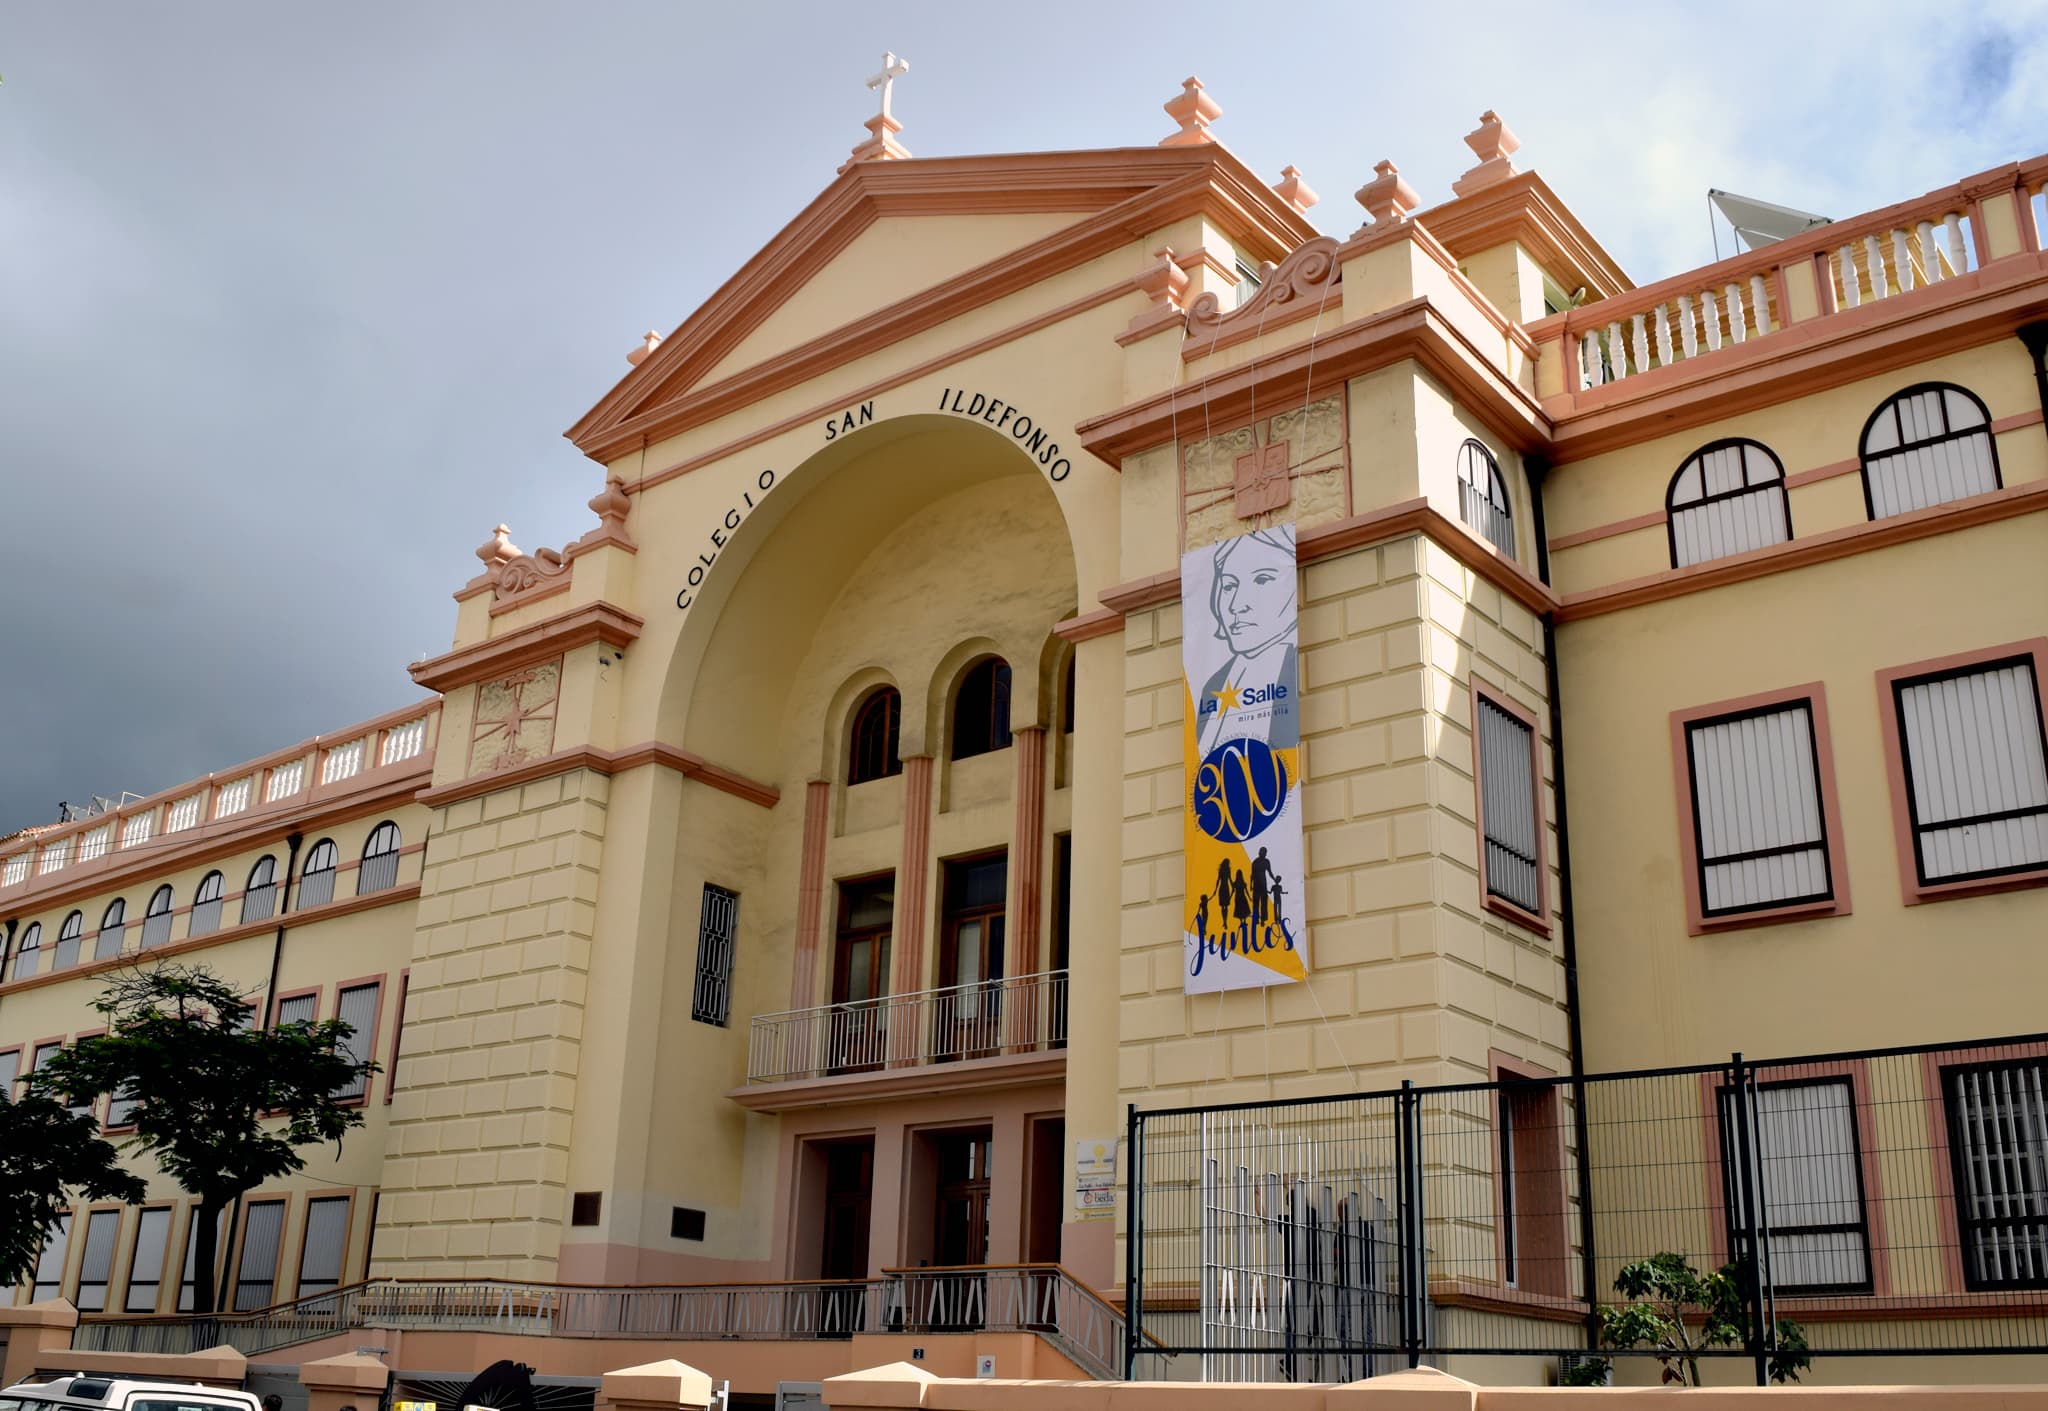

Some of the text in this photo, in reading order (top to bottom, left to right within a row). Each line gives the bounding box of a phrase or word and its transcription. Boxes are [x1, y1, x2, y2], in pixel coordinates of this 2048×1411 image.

[676, 388, 1071, 610] COLEGIO SAN ILDEFONSO
[1200, 683, 1287, 715] La Salle
[1238, 714, 1254, 722] mira
